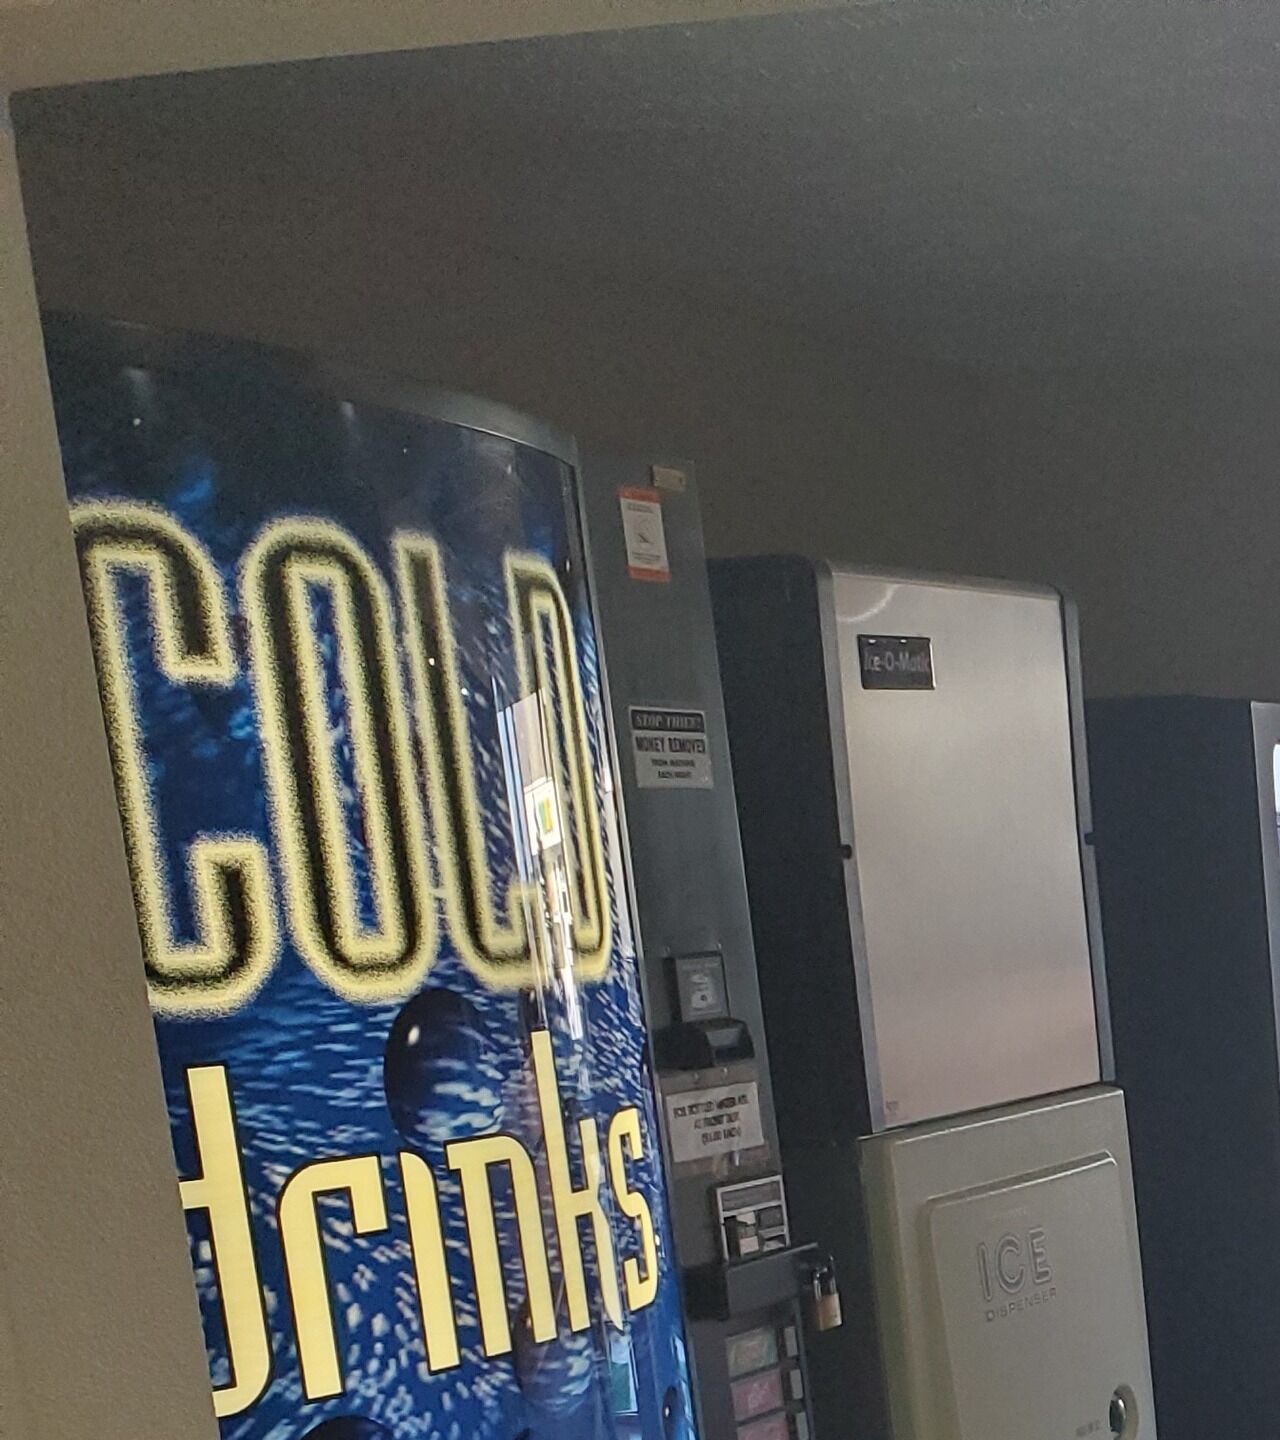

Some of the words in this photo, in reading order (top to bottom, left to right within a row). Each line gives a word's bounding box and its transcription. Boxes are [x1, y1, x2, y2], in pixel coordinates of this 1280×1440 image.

[635, 712, 663, 730] STOP
[69, 500, 614, 1014] COLD
[635, 735, 665, 753] MONEY
[976, 1225, 1053, 1303] ICE
[985, 1288, 1057, 1322] DISPENSER
